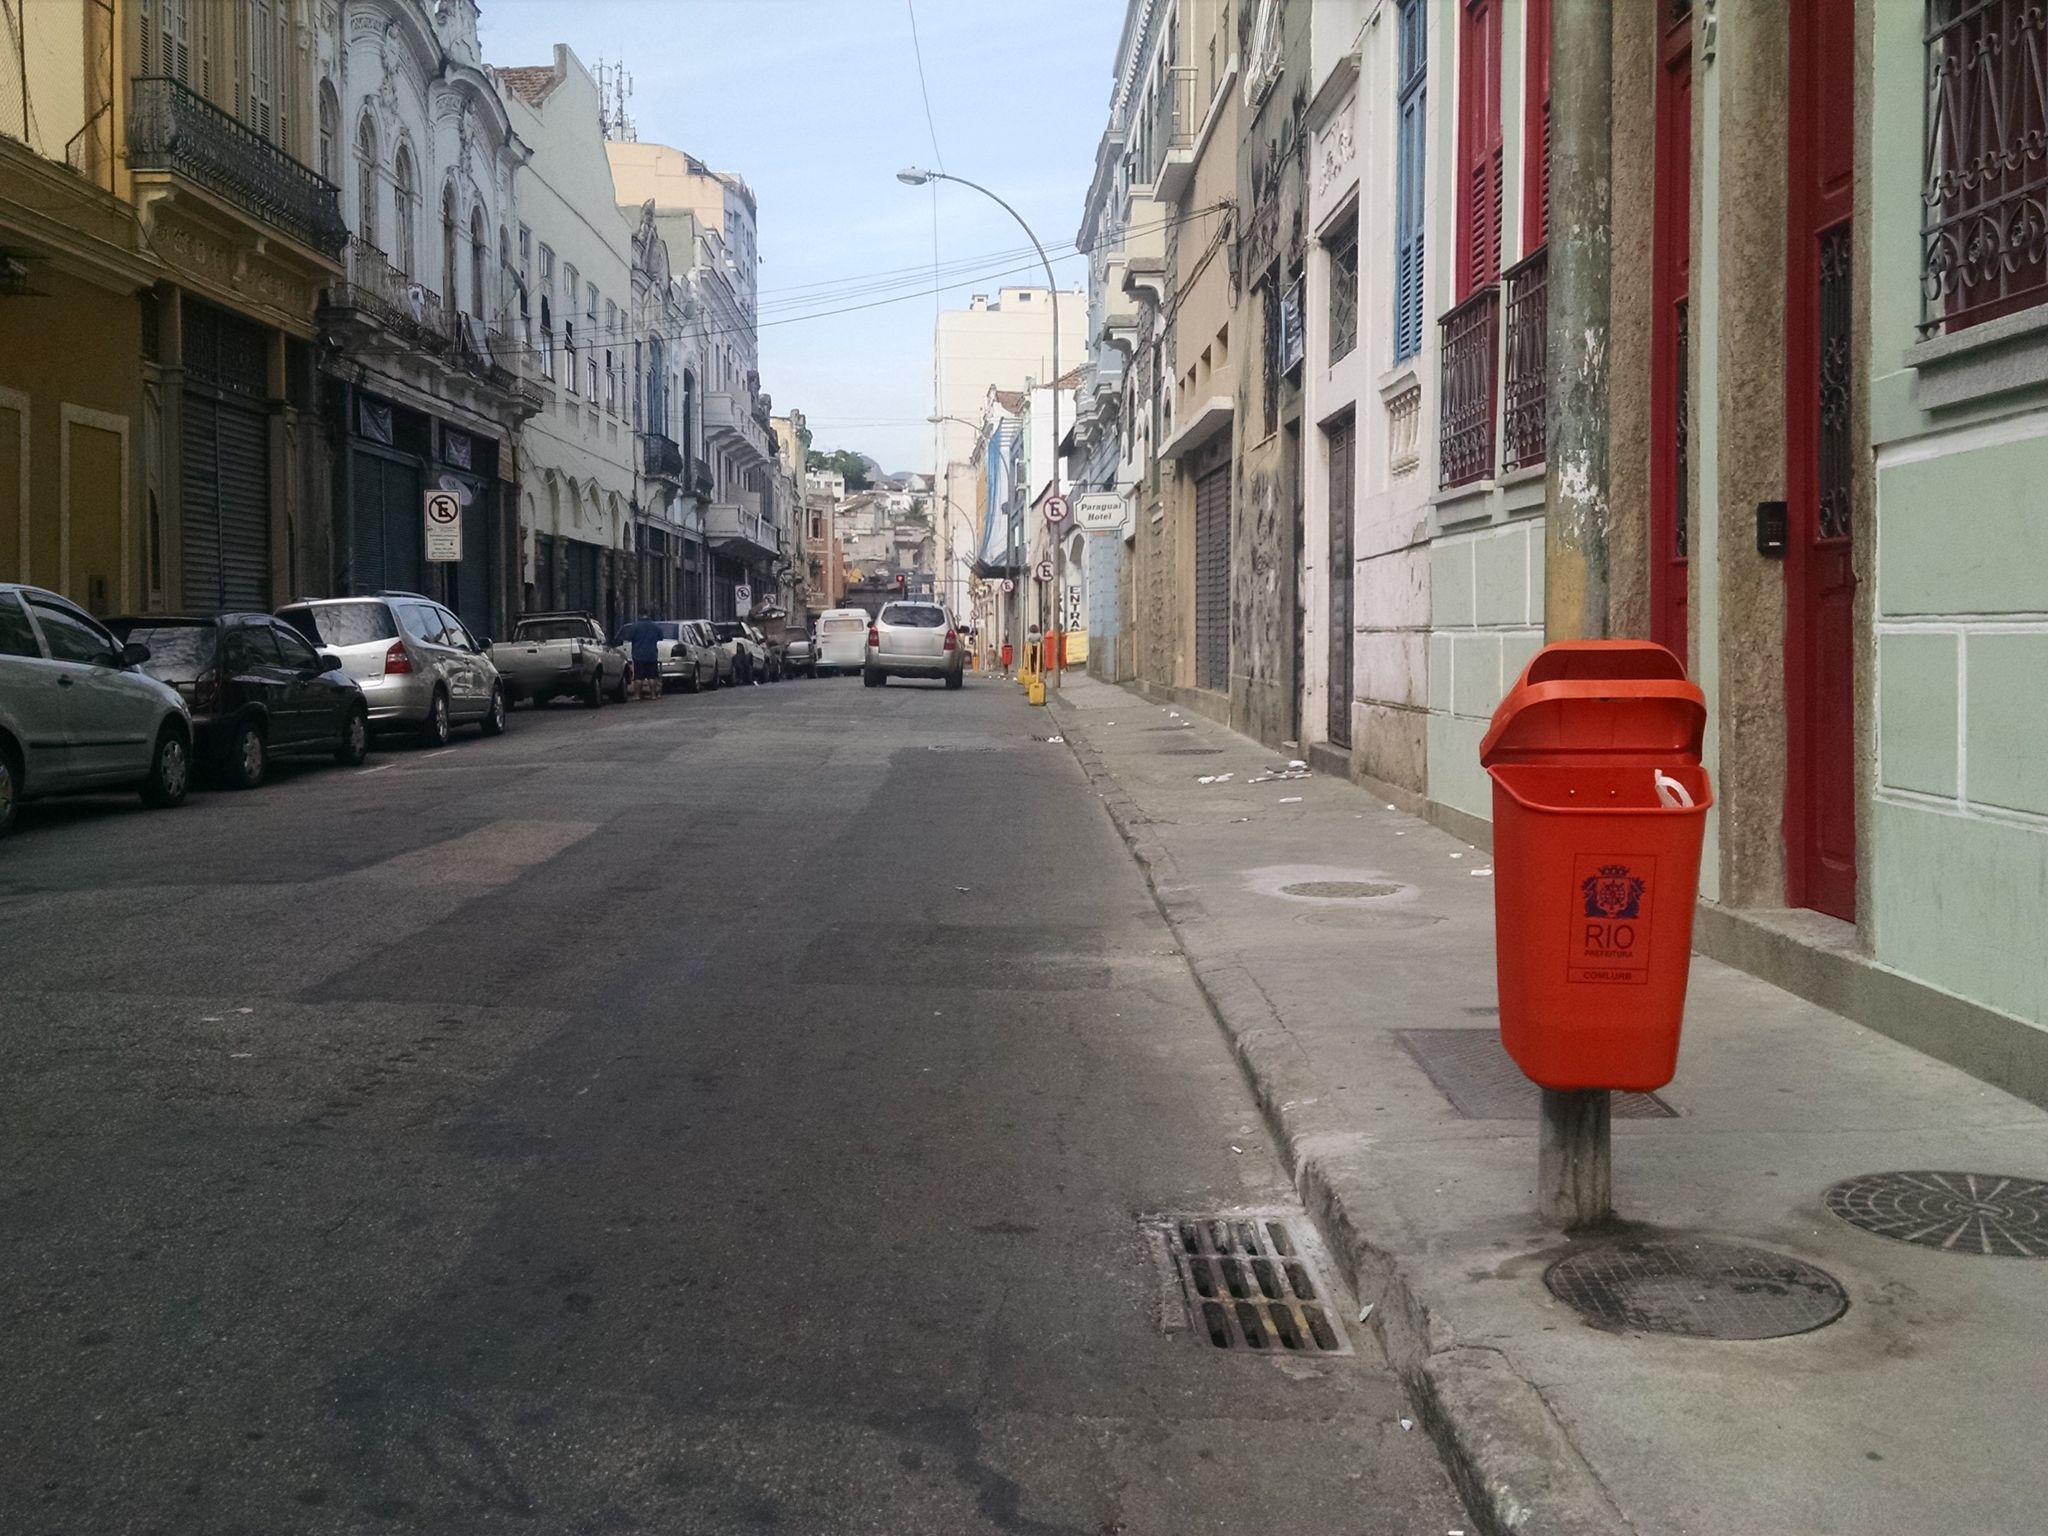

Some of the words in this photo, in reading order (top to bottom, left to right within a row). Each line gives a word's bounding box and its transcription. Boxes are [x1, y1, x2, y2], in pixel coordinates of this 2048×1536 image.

[1087, 512, 1112, 521] Hotel
[1585, 924, 1635, 949] RIO
[1584, 970, 1632, 981] COMLURB
